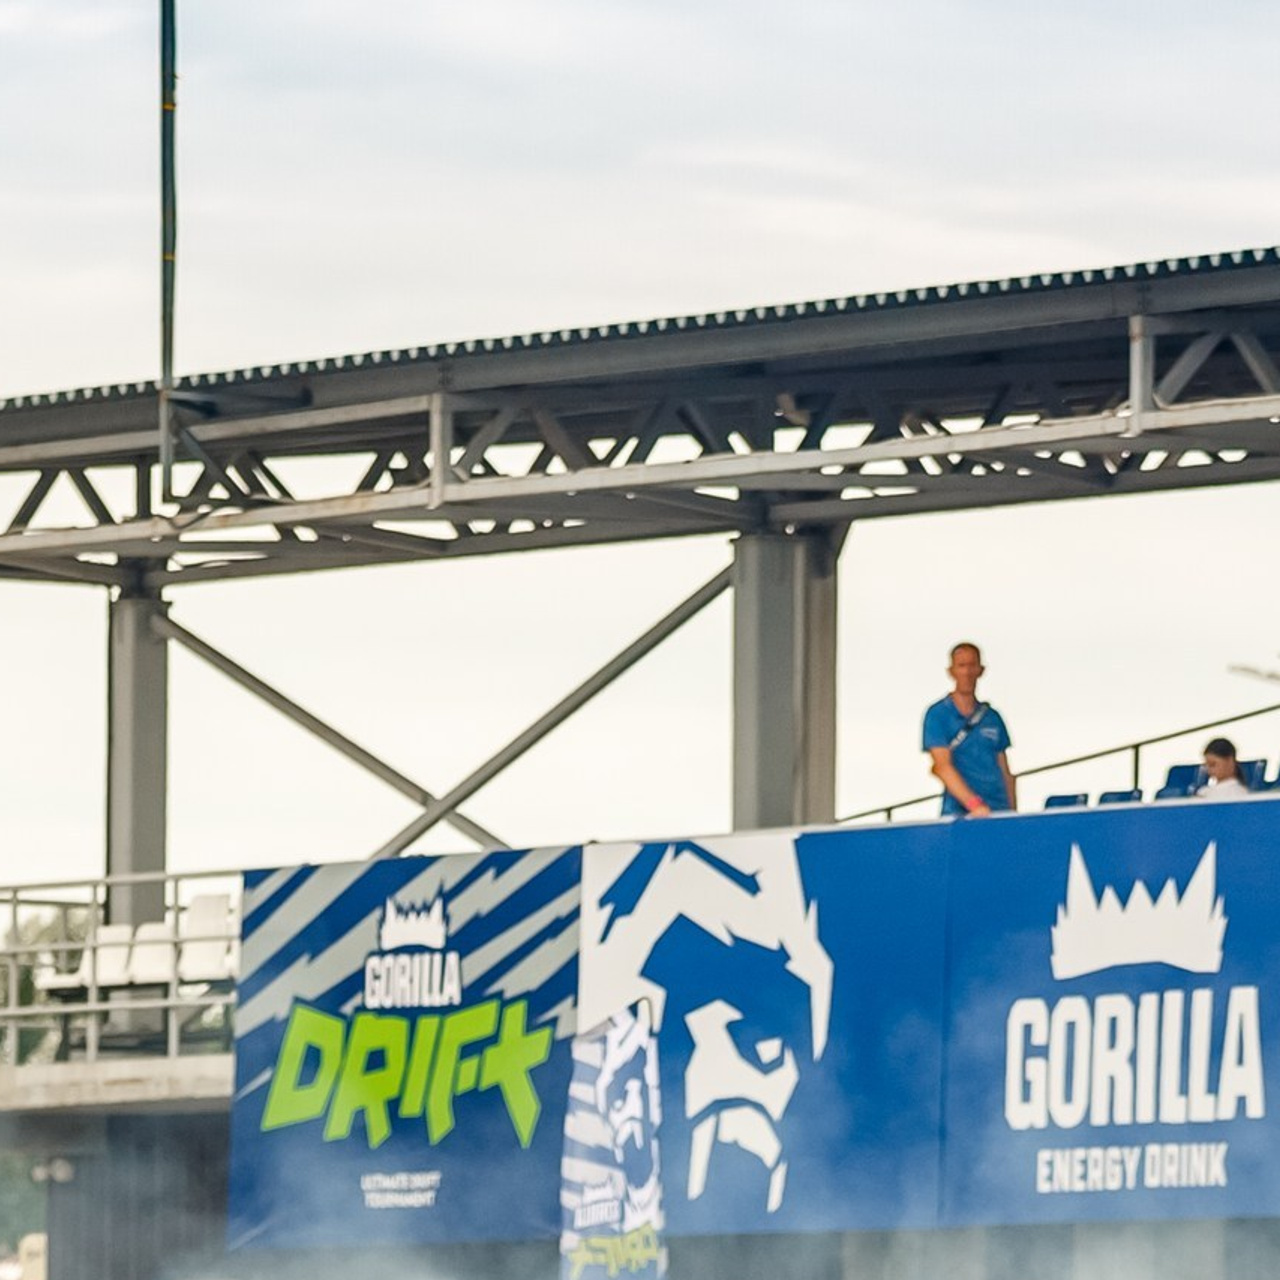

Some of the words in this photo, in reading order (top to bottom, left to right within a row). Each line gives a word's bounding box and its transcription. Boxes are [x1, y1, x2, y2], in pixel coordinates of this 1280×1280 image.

[365, 950, 461, 1009] GORILLA
[1004, 985, 1265, 1131] GORILLA
[1036, 1145, 1141, 1193] ENERGY
[1144, 1142, 1228, 1188] DRINK
